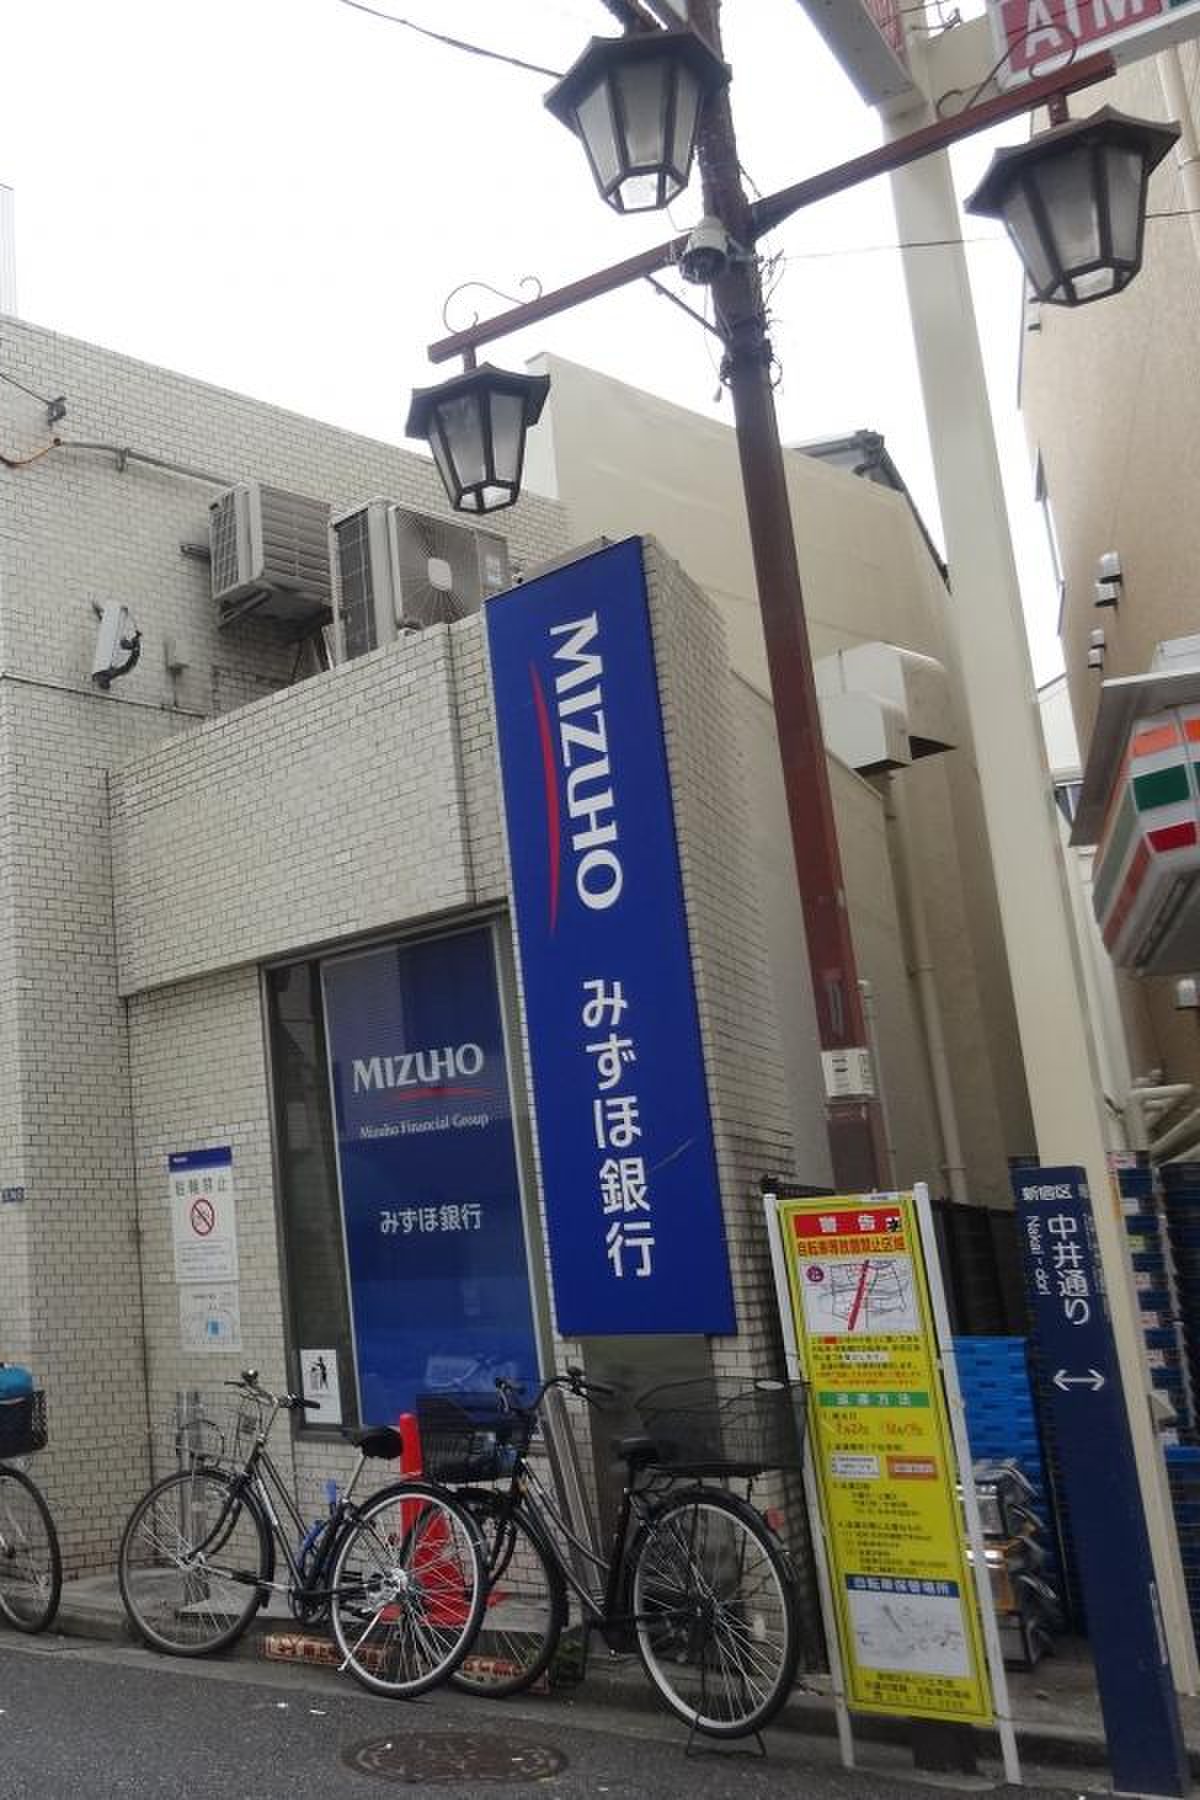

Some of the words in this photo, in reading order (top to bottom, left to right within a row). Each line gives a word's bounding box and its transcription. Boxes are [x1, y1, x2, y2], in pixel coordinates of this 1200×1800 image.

[549, 610, 625, 912] MIZUHO
[351, 1042, 485, 1094] MIZUHO
[359, 1122, 400, 1139] Mizuho
[401, 1115, 449, 1135] Financial
[451, 1111, 489, 1131] Group
[580, 978, 656, 1279] みずほ銀行
[379, 1202, 483, 1235] みずほ銀行
[1046, 1212, 1091, 1326] 中井通り
